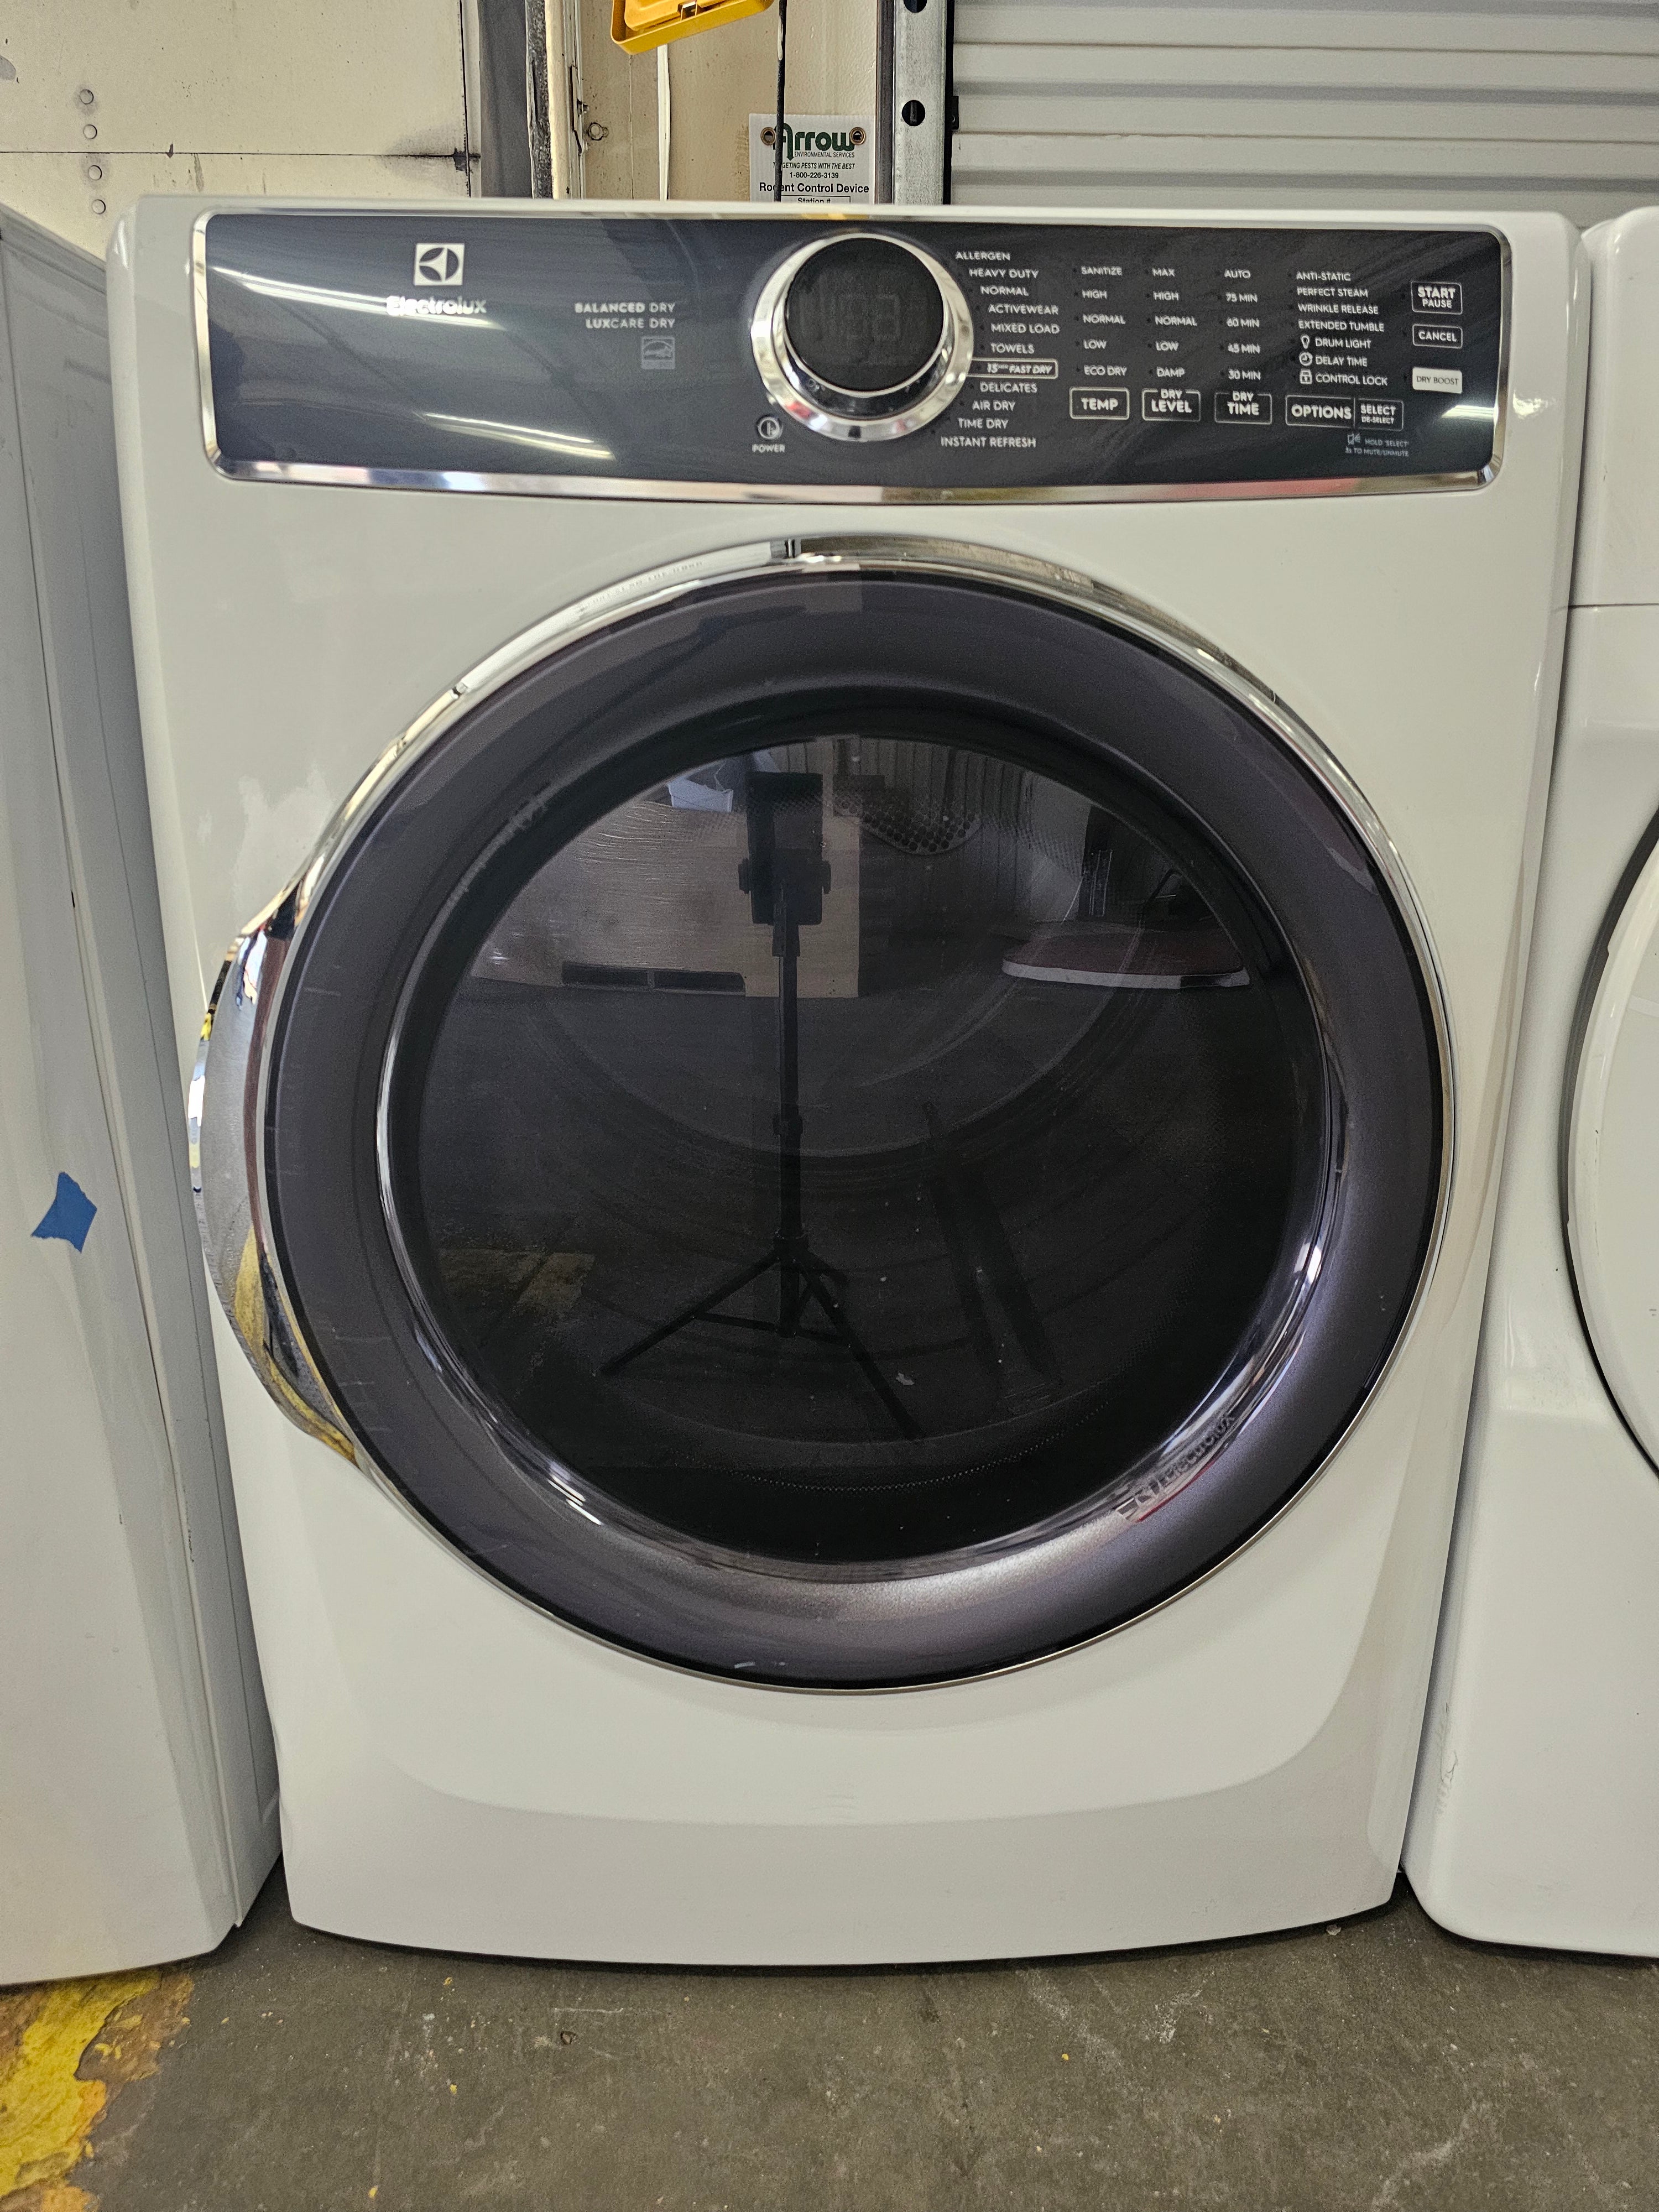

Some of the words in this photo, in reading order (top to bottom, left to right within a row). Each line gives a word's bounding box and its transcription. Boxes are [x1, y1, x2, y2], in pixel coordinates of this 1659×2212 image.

[773, 123, 855, 161] Arrow
[797, 183, 833, 193] Control
[836, 184, 869, 193] Device
[956, 251, 1010, 260] ALLERGEN
[969, 268, 1005, 278] HEAVY
[1009, 269, 1039, 278] DUTY
[1081, 267, 1122, 275] SANITIZE
[1152, 268, 1175, 276] MAX
[1224, 269, 1250, 278] AUTO
[1297, 272, 1350, 281] ANTI-STATIC
[980, 285, 1029, 296] NORMAL
[1082, 289, 1107, 299] HIGH
[1154, 291, 1179, 300] HIGH
[1297, 286, 1335, 296] PERFECT
[1338, 288, 1368, 297] STEAM
[1417, 286, 1456, 299] START
[1226, 293, 1237, 302] 75
[1239, 294, 1258, 302] MIN
[387, 295, 487, 316] Electrolux
[575, 302, 645, 313] BALANCED
[649, 302, 675, 312] DRY
[1298, 304, 1338, 313] WRINKLE
[1341, 304, 1378, 314] RELEASE
[1422, 299, 1452, 309] PAUSE
[988, 304, 1058, 315] ACTIVEWEAR
[586, 318, 644, 328] LUXCARE
[650, 318, 675, 328] DRY
[1083, 314, 1125, 324] NORMAL
[1155, 316, 1197, 326] NORMAL
[1227, 317, 1239, 327] 60
[1240, 319, 1259, 327] MIN
[991, 323, 1026, 333] MIXED
[1029, 324, 1060, 333] LOAD
[1298, 319, 1347, 330] EXTENDED
[1349, 321, 1384, 332] TUMBLE
[1418, 331, 1457, 342] CANCEL
[1084, 339, 1106, 349] LOW
[1156, 341, 1178, 351] LOW
[1315, 337, 1343, 347] DRUM
[1345, 339, 1371, 348] LIGHT
[991, 343, 1034, 354] TOWELS
[1228, 343, 1239, 353] 45
[1241, 344, 1260, 353] MIN
[1316, 355, 1344, 365] DELAY
[1347, 356, 1367, 367] TIME
[1009, 364, 1031, 373] FAST
[1032, 365, 1052, 374] DRY
[1084, 365, 1105, 375] ECO
[1107, 366, 1126, 375] DRY
[1157, 367, 1185, 377] DAMP
[1229, 369, 1240, 379] 30
[1242, 371, 1261, 380] MIN
[1316, 372, 1360, 384] CONTROL
[1363, 375, 1387, 385] LOCK
[1433, 376, 1459, 385] BOOST
[980, 382, 1037, 393] DELICATES
[1161, 388, 1182, 399] DRY
[1232, 391, 1254, 402] DRY
[973, 400, 990, 410] AIR
[993, 400, 1015, 410] DRY
[1081, 398, 1118, 410] TEMP
[1151, 399, 1192, 413] LEVEL
[1227, 401, 1260, 415] TIME
[1291, 404, 1352, 419] OPTIONS
[1360, 404, 1396, 415] SELECT
[958, 418, 983, 428] TIME
[986, 418, 1008, 429] DRY
[941, 436, 986, 447] INSTANT
[990, 437, 1036, 447] REFRESH
[752, 444, 785, 453] POWER
